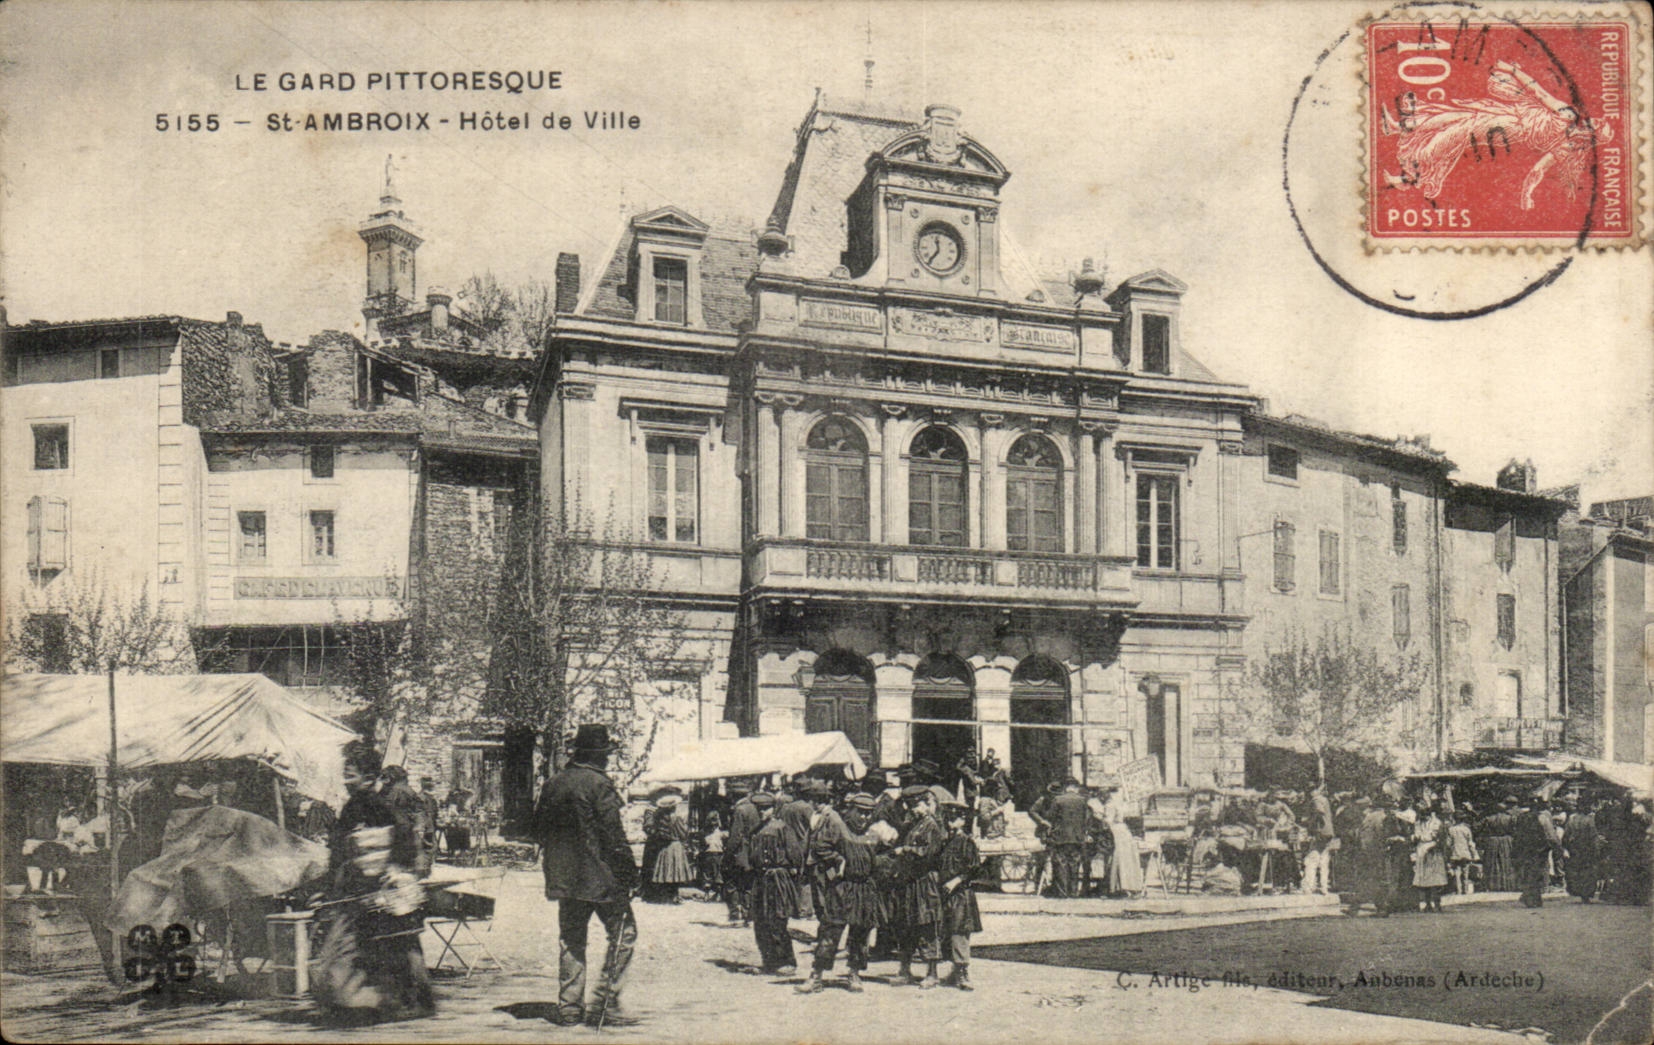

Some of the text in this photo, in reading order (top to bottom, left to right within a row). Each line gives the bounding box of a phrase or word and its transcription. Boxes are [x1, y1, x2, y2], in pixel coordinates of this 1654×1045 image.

[1397, 36, 1452, 86] 10
[1603, 147, 1622, 228] FRANÇAISE
[1387, 208, 1472, 228] POSTES
